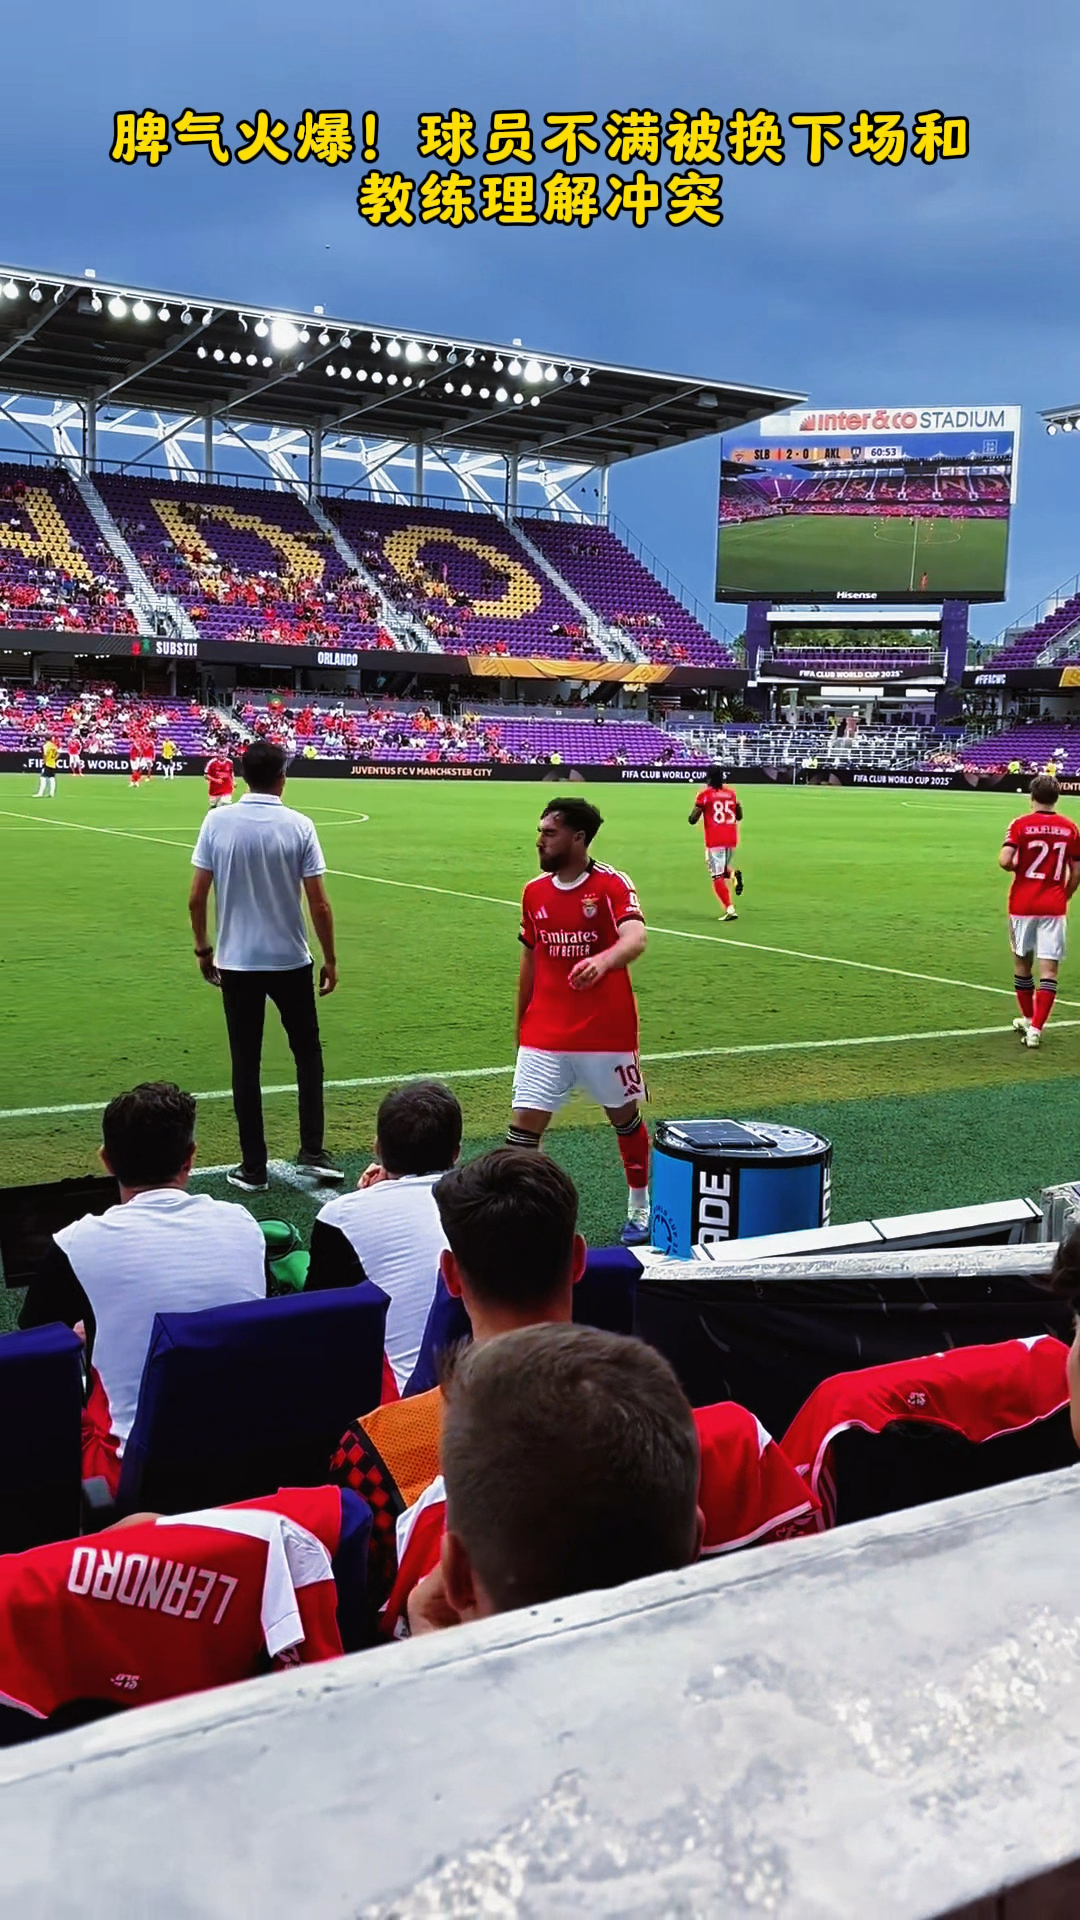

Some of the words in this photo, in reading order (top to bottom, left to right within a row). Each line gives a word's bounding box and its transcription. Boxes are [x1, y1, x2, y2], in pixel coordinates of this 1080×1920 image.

[920, 410, 1005, 429] STADIUM
[754, 449, 770, 460] SLB
[786, 449, 792, 460] 2
[803, 449, 809, 459] 0
[824, 448, 841, 459] AKL
[870, 447, 897, 457] 60:53
[836, 591, 878, 599] Hisense
[317, 651, 358, 666] ORLANDO
[28, 758, 46, 768] FIF
[56, 760, 85, 769] CLB
[88, 761, 129, 770] WORLD
[350, 766, 396, 775] JUVENTUS
[397, 767, 408, 775] FC
[409, 767, 416, 775] V
[416, 767, 472, 776] MANCHESTER
[473, 768, 492, 776] CITY
[621, 770, 639, 779] FIFA
[640, 771, 661, 779] CLUB
[662, 771, 690, 779] WORLD
[691, 771, 707, 779] CUP
[853, 774, 868, 783] FIFA
[868, 775, 886, 783] CLUB
[888, 776, 913, 784] WORLD
[914, 776, 929, 785] CUP
[713, 800, 735, 824] 85
[1025, 840, 1067, 881] 21
[540, 929, 598, 944] Emirates
[549, 944, 560, 957] FLY
[561, 944, 590, 957] BETTER
[614, 1064, 641, 1087] 10
[67, 1546, 238, 1625] LEANDRO
